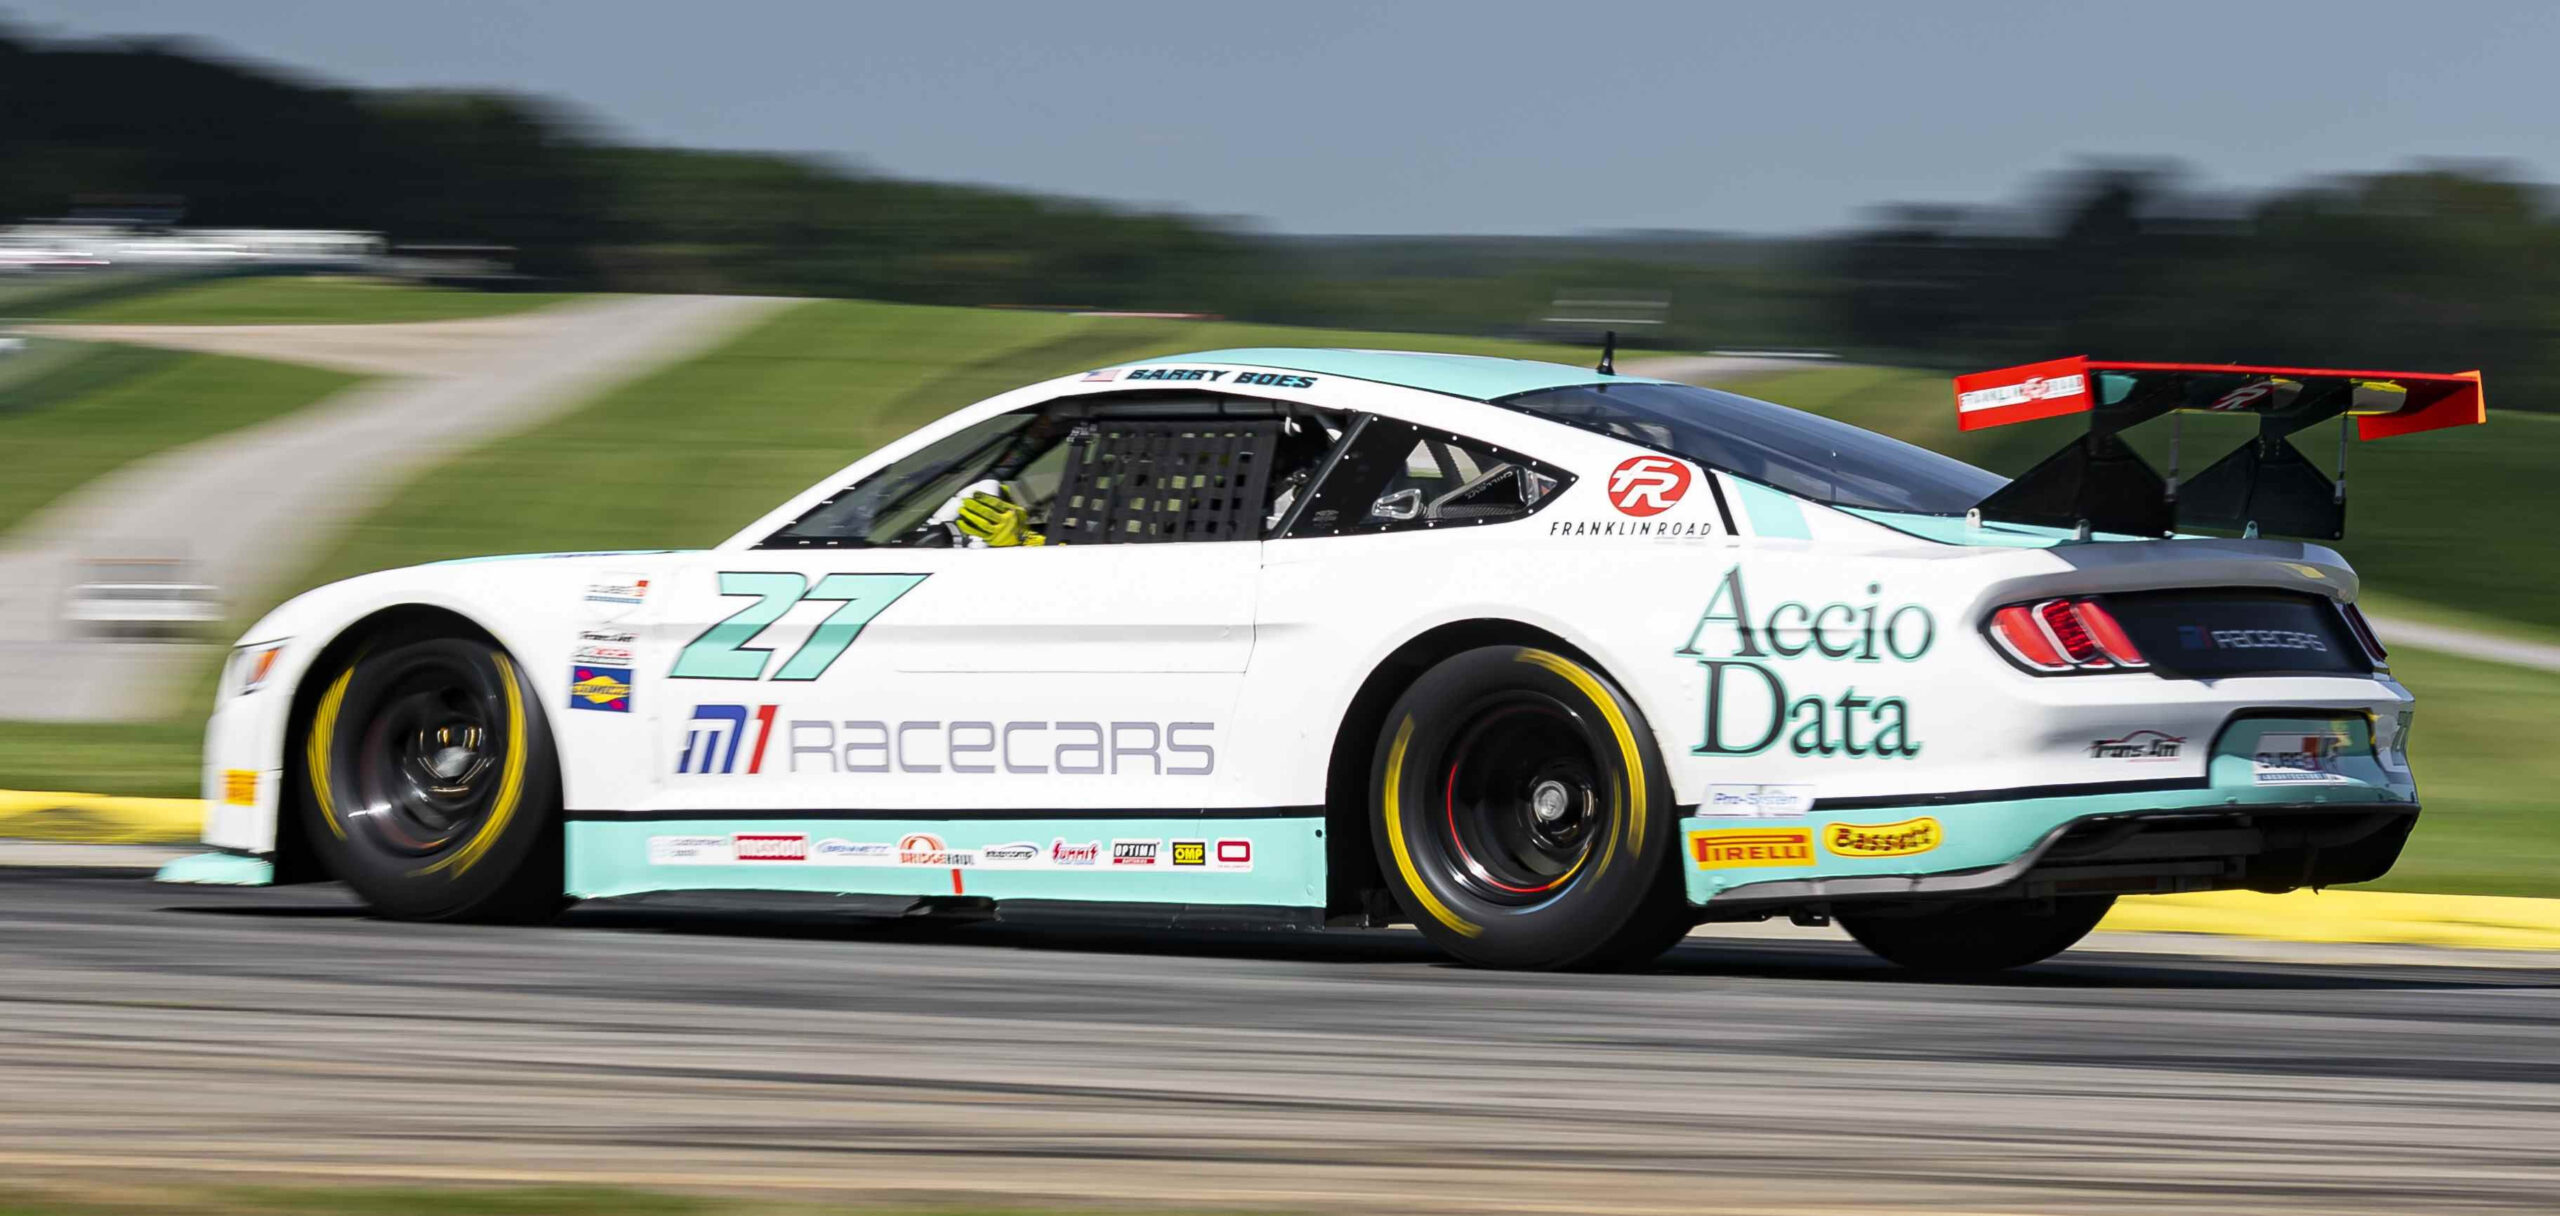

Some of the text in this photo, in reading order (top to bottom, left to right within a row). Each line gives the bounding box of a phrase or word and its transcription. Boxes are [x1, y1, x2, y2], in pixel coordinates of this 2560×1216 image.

[1126, 368, 1318, 389] BARRY BOES
[1549, 521, 1712, 536] FRANKLIN ROAD
[668, 571, 935, 682] 27
[1674, 563, 1936, 662] Accio
[1690, 660, 1922, 759] Data
[676, 704, 778, 775] M1
[1113, 843, 1157, 857] OPTIMA
[1174, 846, 1204, 860] OMP
[1693, 833, 1810, 863] PIRELLI
[1834, 825, 1932, 854] Bassett
